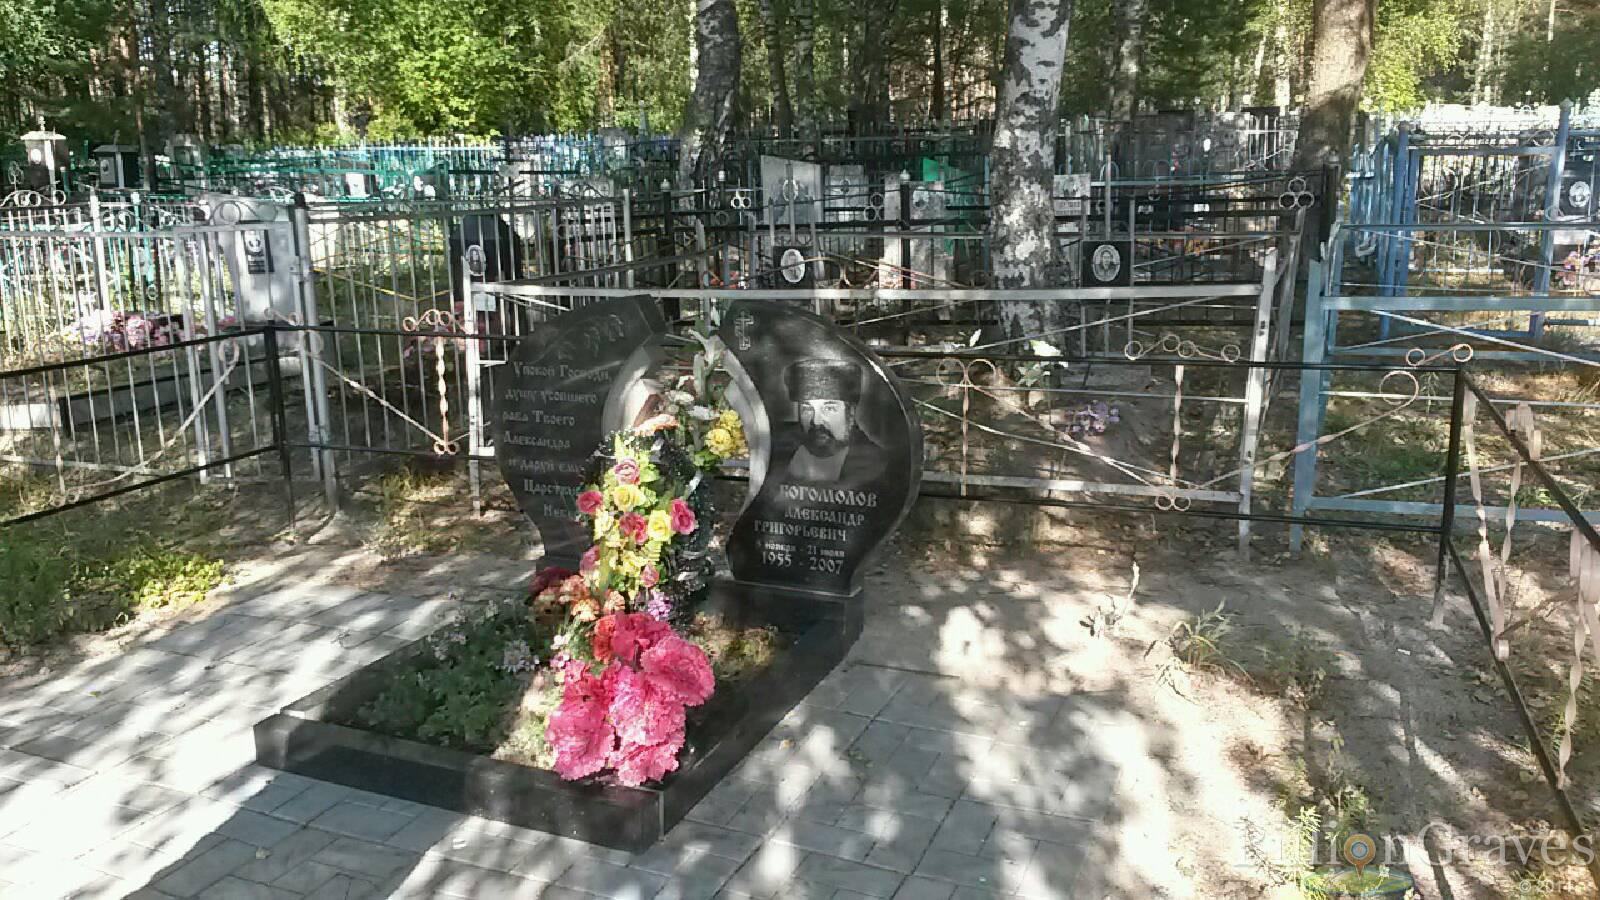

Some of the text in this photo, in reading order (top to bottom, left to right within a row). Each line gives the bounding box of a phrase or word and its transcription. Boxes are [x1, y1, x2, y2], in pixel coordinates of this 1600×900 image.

[780, 484, 877, 507] БОГОМОЛОВ
[784, 506, 865, 527] АЛЕКСАНДР
[753, 519, 847, 542] ГРИГОРЬЕВИЧ
[762, 551, 792, 568] 1955
[808, 556, 845, 575] 2007
